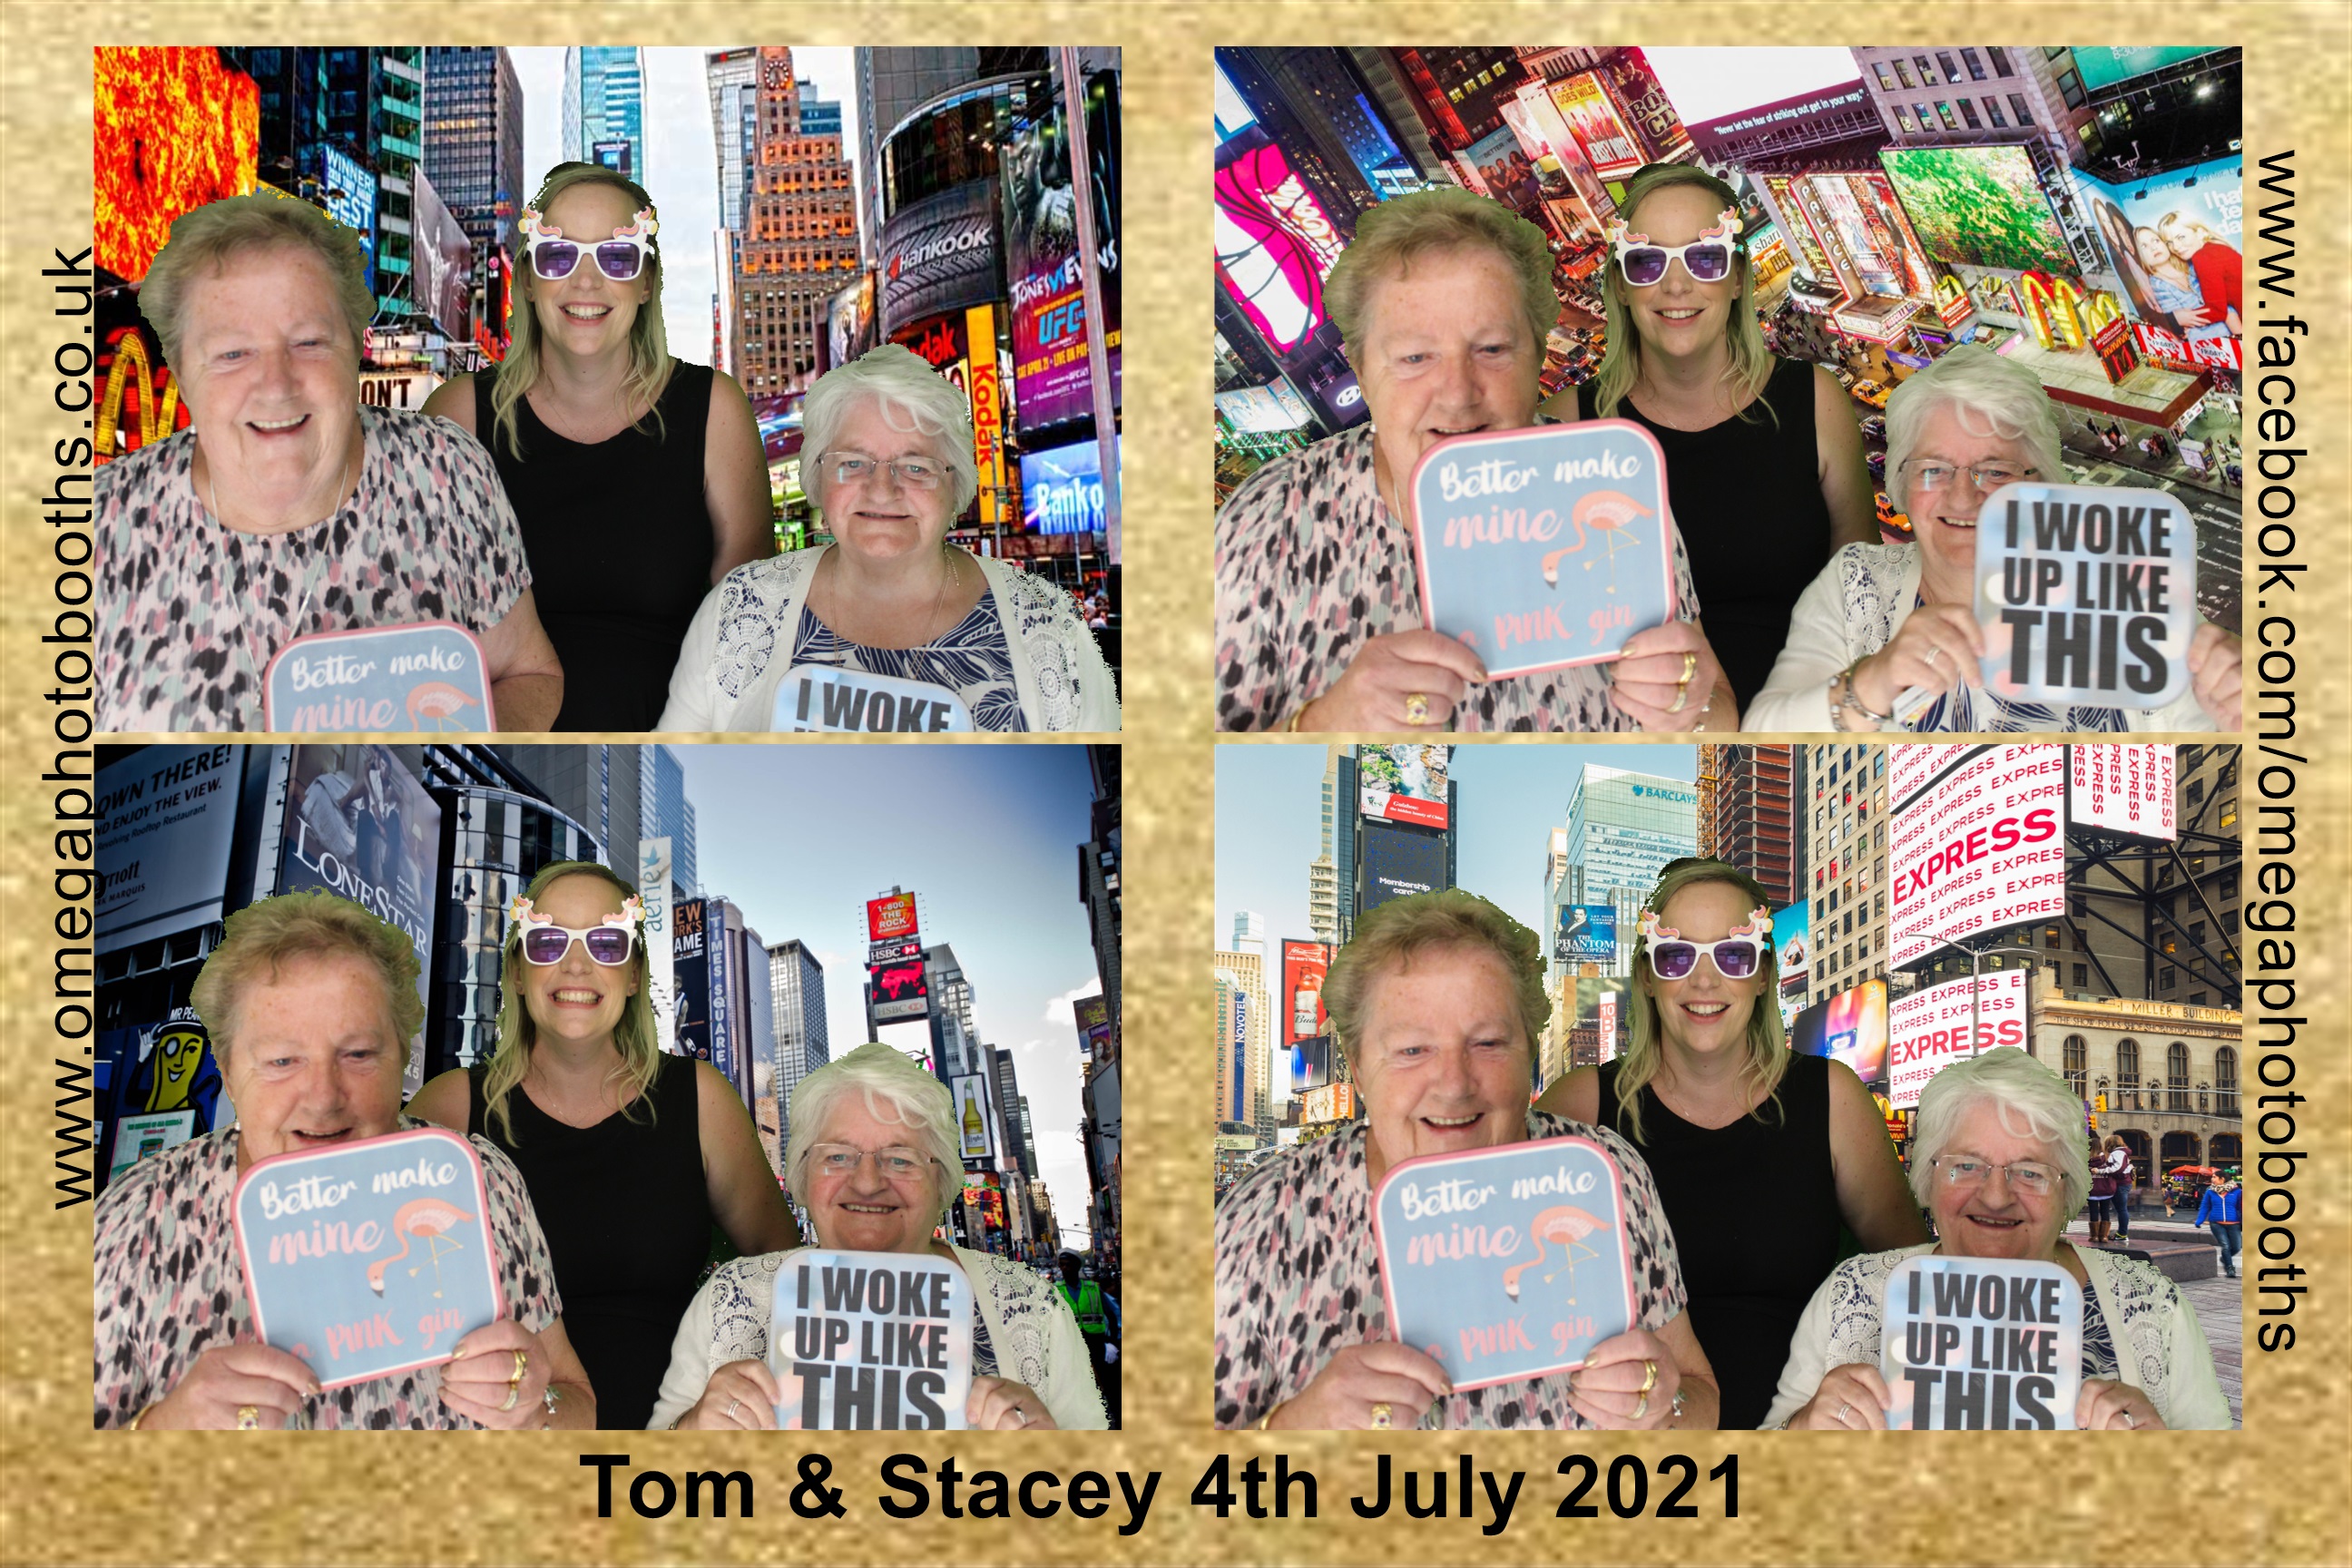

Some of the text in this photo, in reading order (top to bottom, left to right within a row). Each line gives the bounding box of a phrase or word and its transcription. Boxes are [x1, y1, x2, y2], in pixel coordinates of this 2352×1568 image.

[1556, 92, 1577, 105] GOES
[1735, 121, 1743, 132] let
[1742, 118, 1753, 130] the
[1752, 115, 1766, 127] fear
[1766, 113, 1773, 122] of
[1773, 107, 1798, 122] striking
[1798, 103, 1809, 115] out
[1809, 101, 1822, 113] get
[1822, 97, 1829, 109] in
[1829, 95, 1845, 109] your
[327, 145, 375, 193] WINNER!
[1801, 184, 1851, 271] PALACE
[1064, 239, 1118, 283] EVNS
[1039, 299, 1082, 345] UFC
[1054, 350, 1065, 367] LIVE
[1066, 347, 1075, 362] ON
[973, 363, 1000, 467] Kodak
[1439, 448, 1642, 502] Better make
[1443, 505, 1563, 550] mine
[2005, 500, 2172, 558] I WOKE
[2004, 556, 2170, 614] UP LIKE
[1589, 603, 1637, 647] gin
[291, 645, 466, 692] Better make
[2001, 608, 2169, 695] THIS
[291, 694, 398, 732] mine
[797, 678, 951, 732] I WOKE
[94, 743, 232, 816] OWN THERE!
[1646, 787, 1698, 805] BARCLAYS
[1893, 757, 1995, 834] EXPRESS EXPRESS
[2092, 744, 2103, 814] EXPRESS
[2129, 749, 2140, 821] EXPRESS
[2161, 756, 2172, 828] EXPRESS
[94, 777, 222, 838] ND ENJOY THE VIEW.
[96, 803, 207, 853] Revolving Rooftop Restaurant
[1397, 808, 1412, 816] hidden
[1930, 785, 1982, 826] EXPRESS
[1893, 803, 1995, 872] EXPRESS EXPRESS
[1894, 808, 2056, 906] EXPRESS
[94, 860, 141, 894] arriott
[109, 883, 145, 901] MARQUIS
[1379, 877, 1430, 894] Membership
[1931, 868, 1982, 903] EXPRESS
[644, 869, 662, 933] aerie
[674, 901, 702, 926] EW
[877, 901, 905, 913] 1-800
[878, 916, 906, 929] ROCK
[882, 909, 901, 920] THE
[1894, 887, 1995, 943] EXPRESS EXPRESS
[674, 932, 703, 954] AME
[1555, 939, 1615, 950] PHANTOM
[1931, 916, 1983, 946] EXPRESS
[871, 946, 901, 962] HSBC
[709, 916, 726, 1063] TIMES SQUARE
[877, 1004, 907, 1016] HSBC
[1601, 1004, 1615, 1016] 10
[1932, 978, 1999, 1002] EXPRESS
[183, 1006, 201, 1021] PEA
[1236, 996, 1246, 1043] NOVOTEL
[1893, 997, 2015, 1034] EXPRESS EXPRESS
[2056, 1016, 2071, 1024] THE
[2073, 1017, 2094, 1026] SHOW
[2132, 1003, 2232, 1022] MILLER BUILDING
[1891, 1019, 2024, 1065] EXPRESS
[1893, 1067, 1935, 1085] EXPRESS
[260, 1157, 458, 1220] Better make
[1401, 1166, 1597, 1220] Better make
[269, 1220, 385, 1265] mine
[1407, 1222, 1523, 1267] mine
[797, 1265, 951, 1318] I WOKE
[1908, 1270, 2061, 1324] I WOKE
[418, 1308, 466, 1350] gin
[794, 1316, 948, 1370] UP LIKE
[1552, 1315, 1598, 1357] gin
[1906, 1321, 2057, 1375] UP LIKE
[792, 1362, 946, 1430] THIS
[1904, 1367, 2055, 1430] THIS
